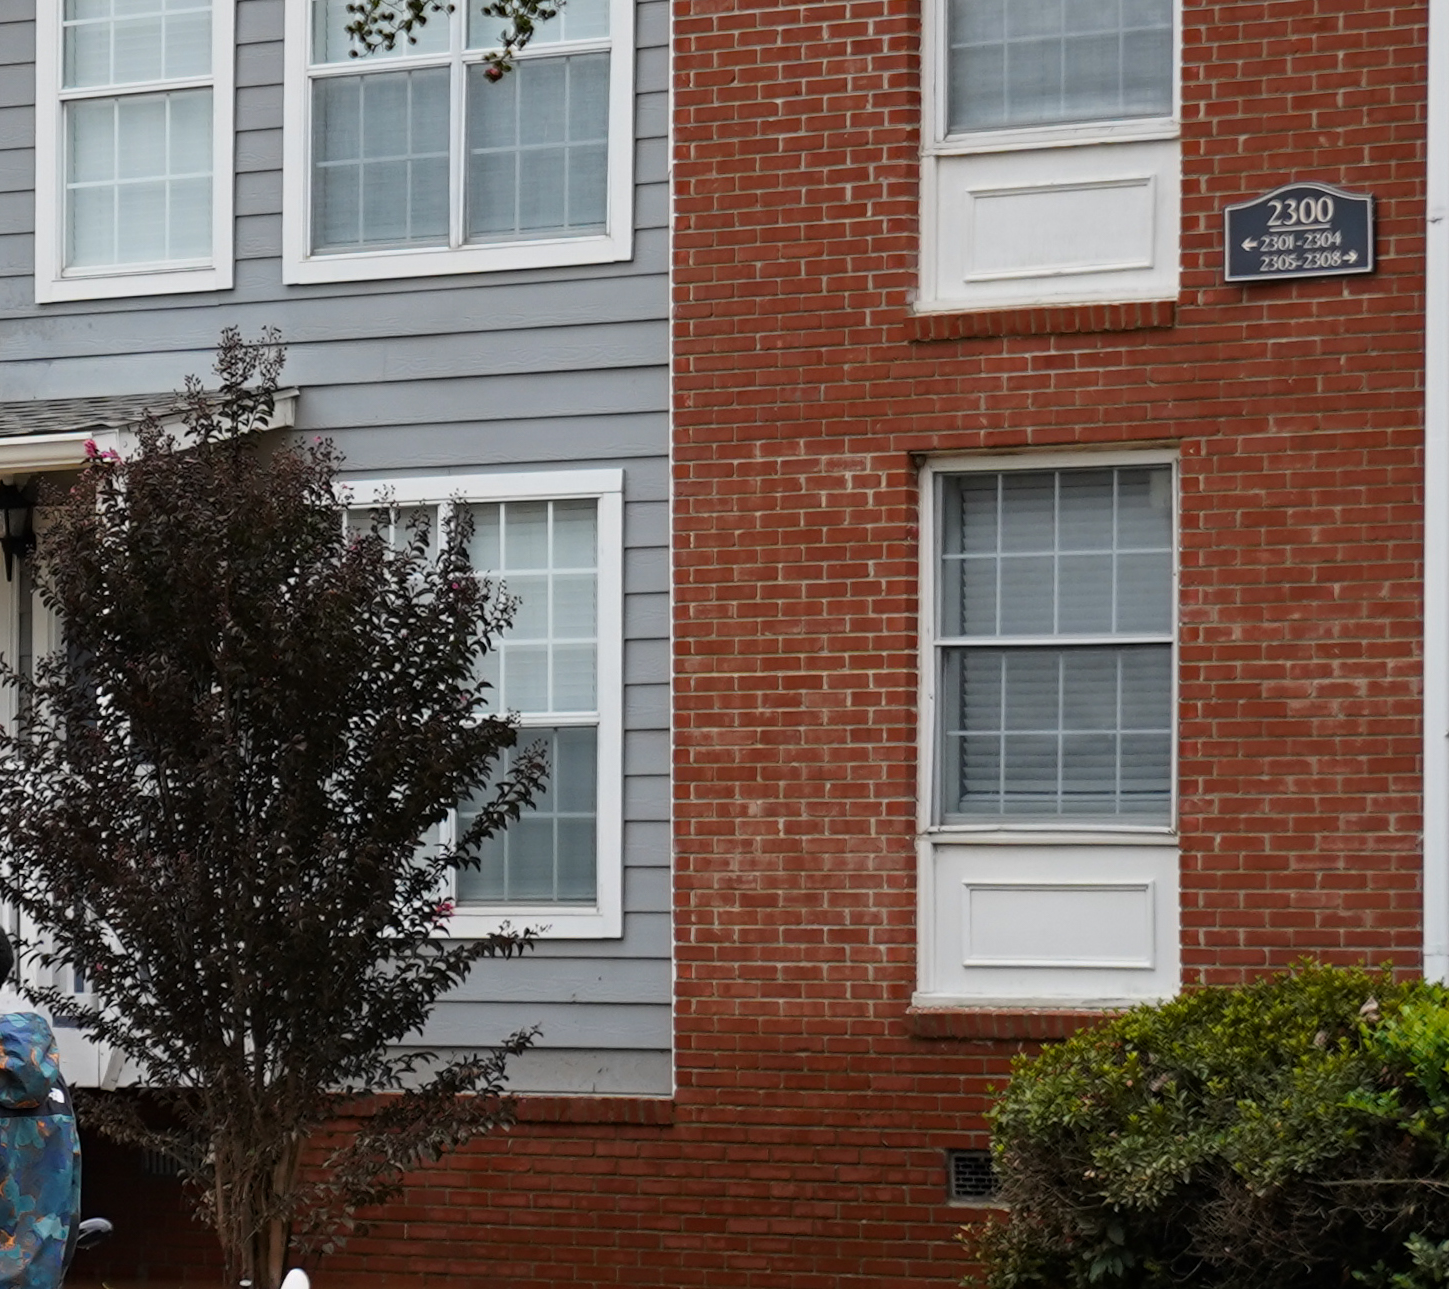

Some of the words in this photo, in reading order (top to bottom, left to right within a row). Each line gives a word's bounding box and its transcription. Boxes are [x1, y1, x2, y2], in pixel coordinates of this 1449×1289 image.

[1266, 196, 1335, 226] 2300
[1259, 230, 1343, 252] 2301-2304
[1259, 250, 1342, 272] 2305-2308
